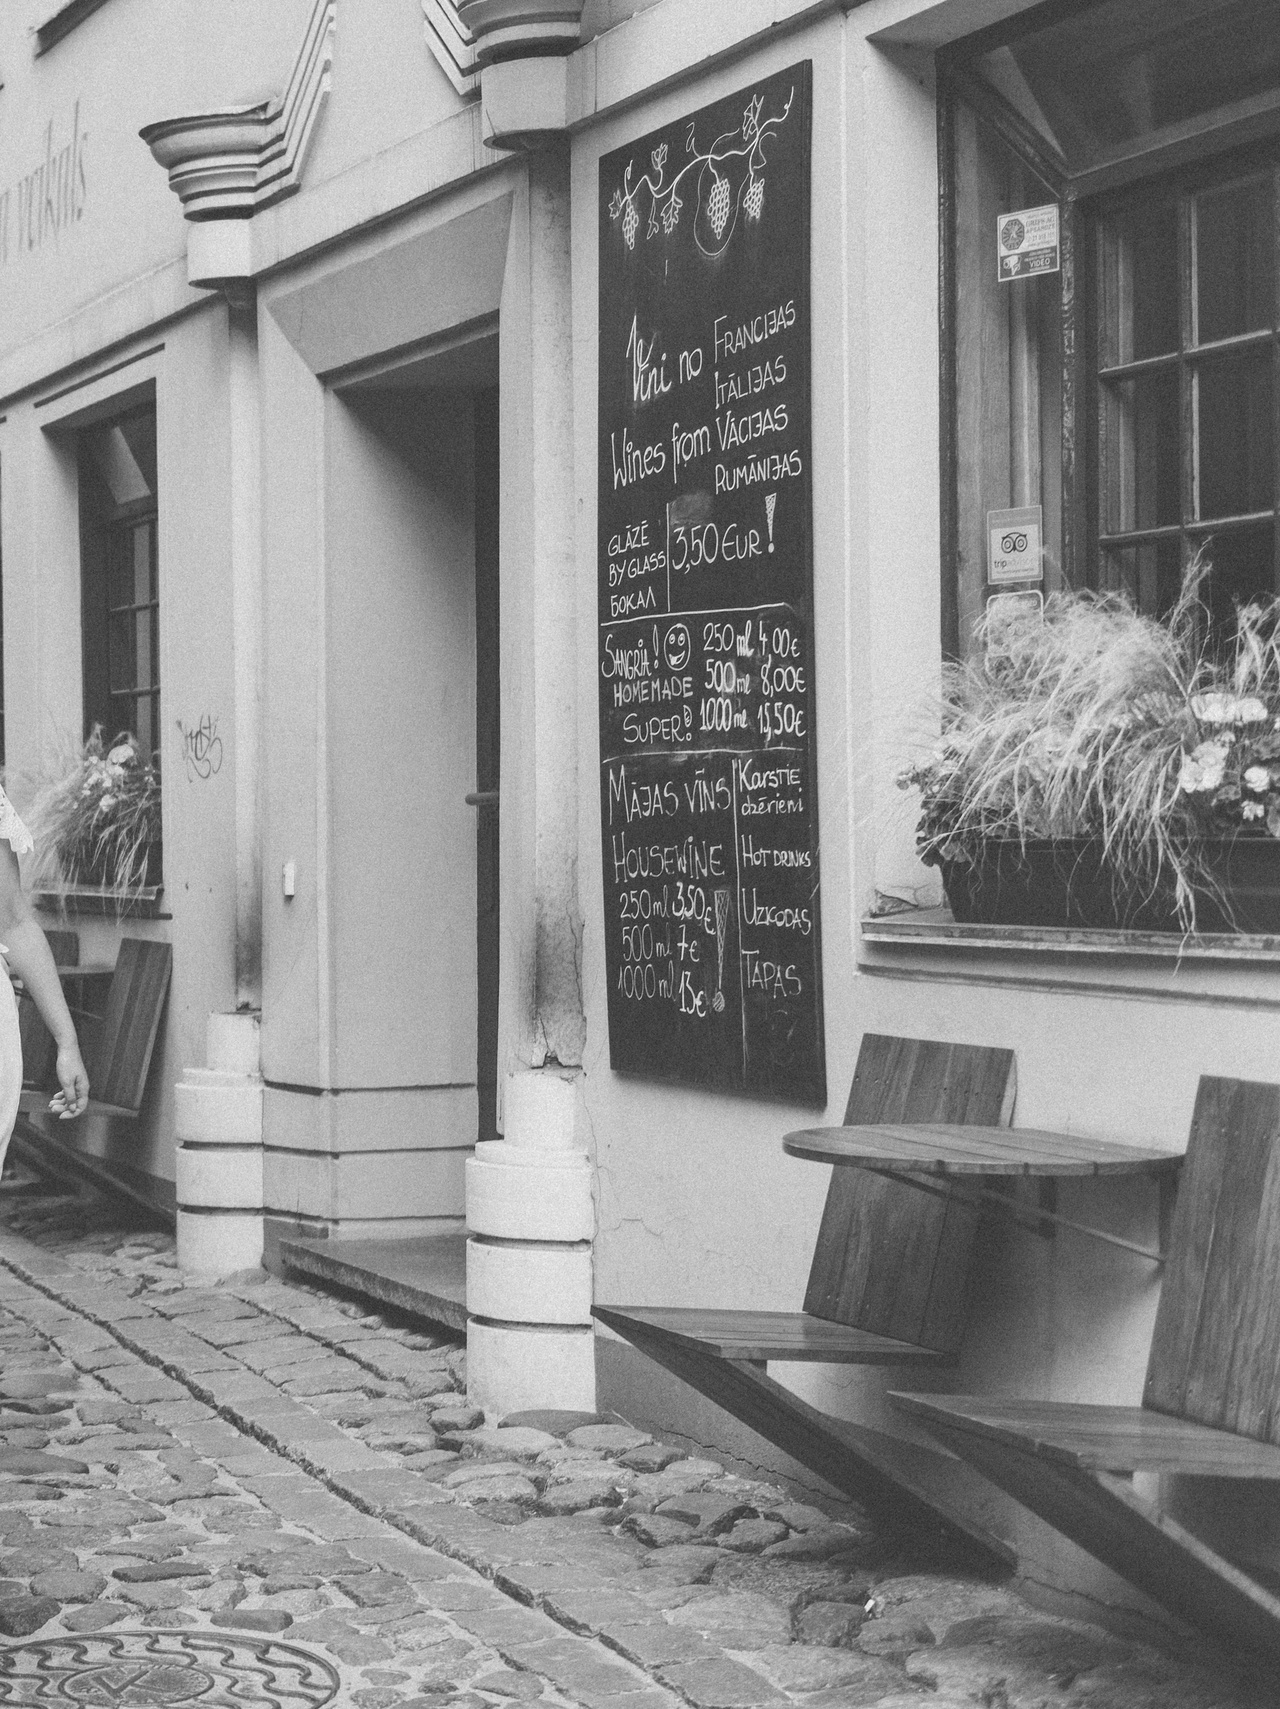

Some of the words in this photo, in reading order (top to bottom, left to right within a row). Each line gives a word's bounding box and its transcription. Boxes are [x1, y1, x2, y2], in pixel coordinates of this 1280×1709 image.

[1029, 257, 1051, 268] VIDEO
[714, 299, 796, 364] FRANCIJAS
[679, 347, 703, 384] no
[714, 355, 787, 410] ITĀLIJAS
[715, 403, 789, 451] VĀCIJAS
[611, 427, 666, 490] Wines
[671, 422, 712, 484] from
[715, 449, 802, 495] RUMĀNIJAS
[608, 563, 626, 588] BY
[627, 550, 666, 580] GLASS
[610, 585, 657, 618] БОКАЛ
[703, 622, 734, 652] 250
[736, 619, 755, 657] ml
[613, 676, 694, 708] HOMEMADE
[704, 658, 736, 693] 500
[699, 697, 733, 732] 1000
[609, 764, 679, 826] MĀJAS
[684, 768, 731, 814] VĪNS
[741, 787, 804, 816] dzērieni
[741, 834, 771, 868] HOT
[773, 850, 812, 868] DRINKS
[620, 889, 651, 919] 250
[652, 885, 670, 918] ml
[622, 923, 654, 962] 500
[677, 924, 700, 963] 7€
[618, 963, 656, 1001] 1000
[741, 949, 802, 999] TAPAS
